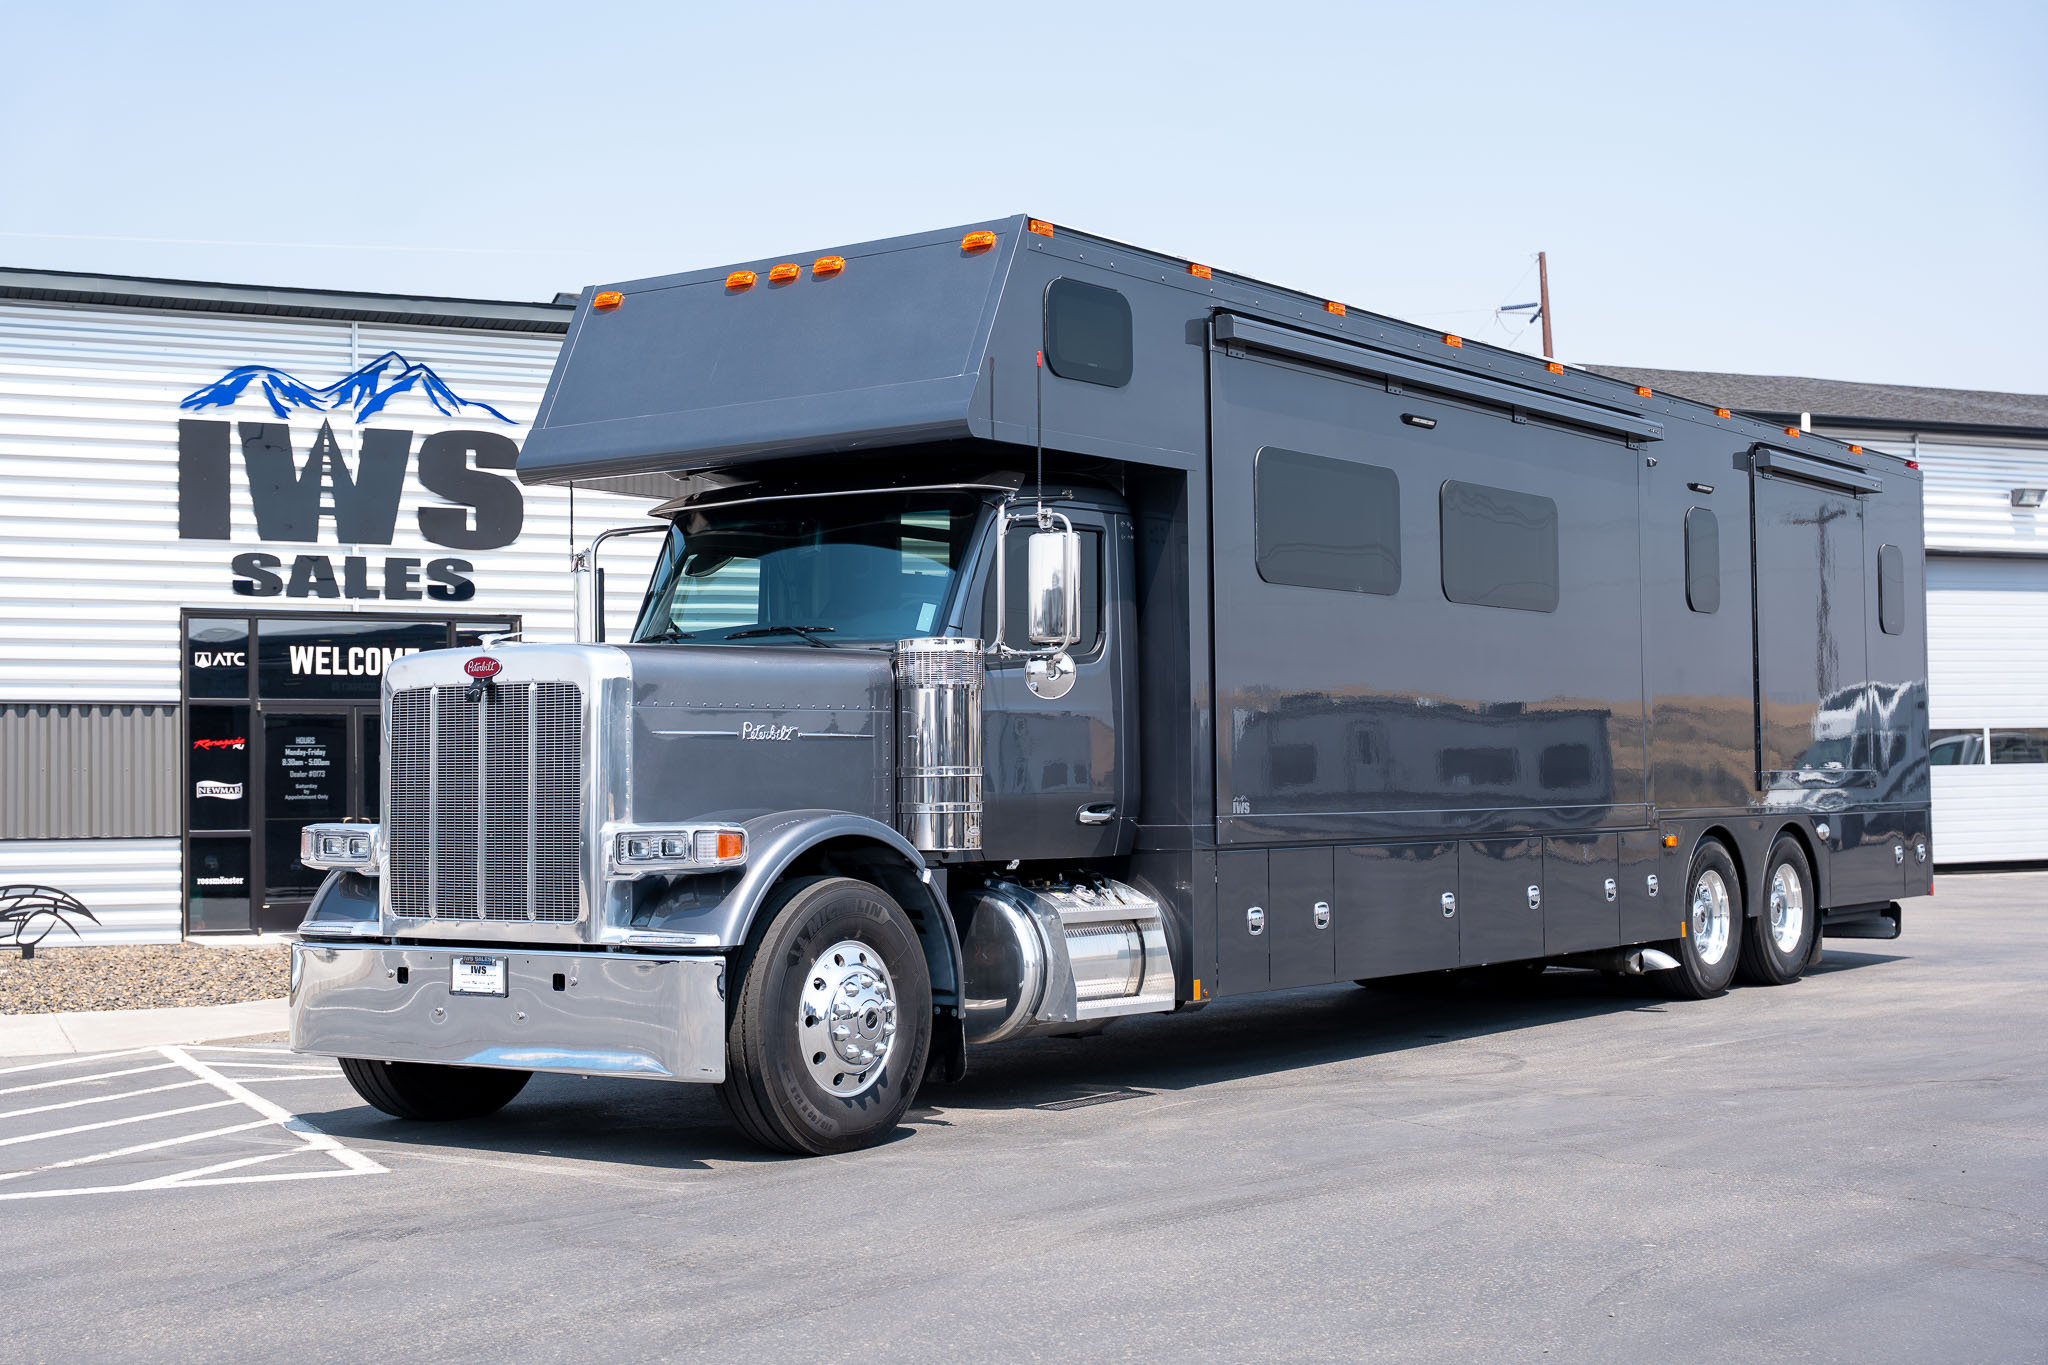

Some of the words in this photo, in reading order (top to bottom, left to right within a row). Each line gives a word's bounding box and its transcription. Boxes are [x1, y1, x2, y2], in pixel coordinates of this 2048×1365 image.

[178, 417, 524, 550] IWS
[232, 553, 476, 600] SALES
[212, 652, 246, 667] ATC
[289, 645, 420, 676] WELCOM
[467, 660, 497, 673] Peterbilt
[742, 721, 799, 741] Peterbilt
[295, 736, 316, 744] HOURS
[198, 786, 241, 795] NEWMAR
[1232, 801, 1250, 814] IWS
[807, 899, 882, 937] MICHELIN
[470, 965, 487, 974] IWS
